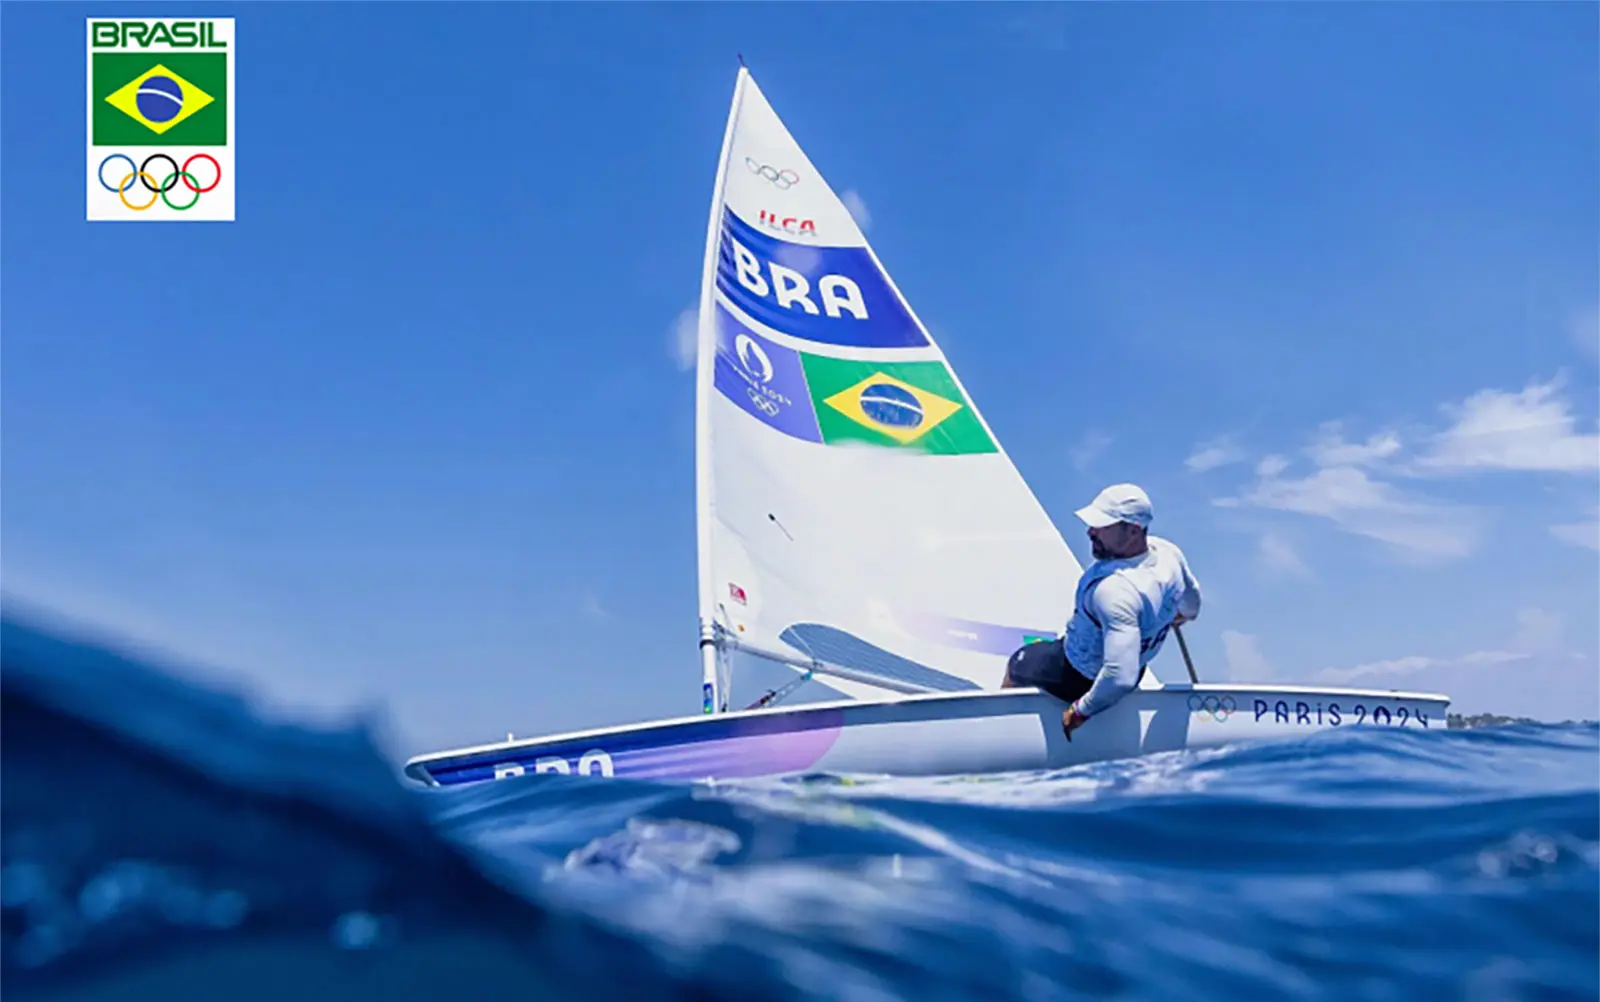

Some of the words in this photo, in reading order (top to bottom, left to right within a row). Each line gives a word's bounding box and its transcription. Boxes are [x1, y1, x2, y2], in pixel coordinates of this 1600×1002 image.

[760, 210, 817, 236] ILCA
[731, 237, 869, 319] BRA
[1354, 704, 1428, 729] 2024
